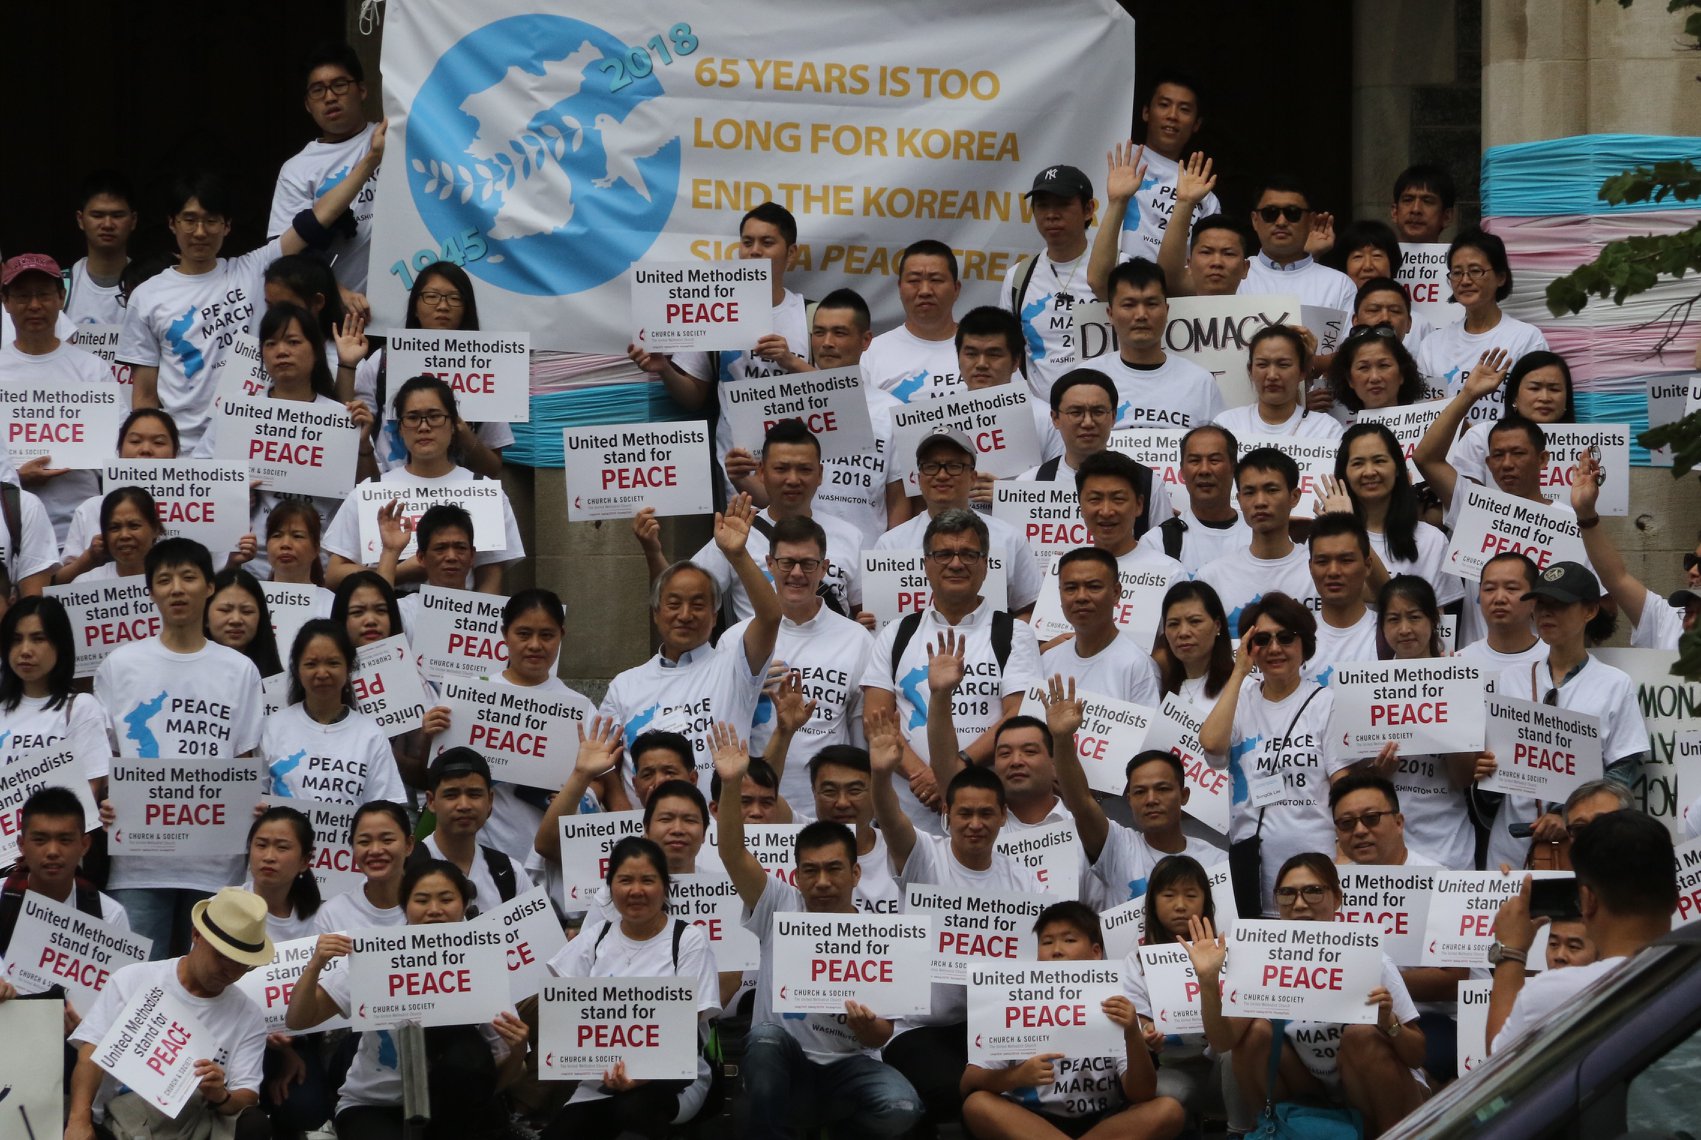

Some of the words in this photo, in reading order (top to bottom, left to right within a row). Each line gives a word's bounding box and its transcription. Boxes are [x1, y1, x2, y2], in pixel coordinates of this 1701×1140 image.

[601, 27, 697, 94] 2018
[694, 57, 740, 88] 65
[746, 58, 871, 94] YEARS
[879, 65, 910, 98] IS
[916, 67, 1000, 101] TOO
[693, 117, 802, 154] LONG
[810, 124, 888, 157] FOR
[897, 128, 1020, 162] KOREA
[779, 183, 854, 216] THE
[863, 186, 1011, 222] KOREAN
[636, 270, 684, 284] United
[688, 269, 767, 282] Methodists
[669, 286, 706, 299] stand
[714, 285, 735, 298] for
[202, 304, 254, 340] MARCH
[666, 302, 739, 324] PEACE
[392, 338, 440, 352] United
[444, 338, 525, 353] Methodists
[425, 354, 466, 368] stand
[471, 356, 492, 369] for
[32, 390, 115, 404] Methodists
[730, 387, 775, 404] United
[780, 376, 859, 397] Methodists
[13, 406, 55, 419] stand
[60, 406, 81, 419] for
[764, 400, 804, 415] stand
[809, 396, 829, 409] for
[225, 403, 275, 421] United
[279, 406, 358, 431] Methodists
[1134, 408, 1190, 427] PEACE
[9, 423, 84, 443] PEACE
[255, 424, 297, 439] stand
[301, 428, 322, 441] for
[569, 437, 618, 450] United
[622, 431, 704, 445] Methodists
[1544, 433, 1624, 446] Methodists
[249, 440, 324, 468] PEACE
[604, 451, 645, 464] stand
[650, 449, 671, 461] for
[109, 468, 157, 481] United
[161, 468, 245, 482] Methodists
[601, 466, 677, 490] PEACE
[832, 471, 872, 487] 2018
[415, 488, 497, 498] Methodists
[819, 495, 868, 504] WASHINGTON
[1468, 492, 1510, 516] United
[1491, 518, 1531, 539] stand
[1534, 529, 1554, 546] for
[85, 617, 161, 647] PEACE
[1339, 670, 1389, 684] United
[1394, 667, 1479, 682] Methodists
[1374, 685, 1417, 699] stand
[1422, 684, 1444, 697] for
[172, 698, 231, 720] PEACE
[446, 684, 497, 704] United
[501, 693, 583, 720] Methodists
[376, 704, 425, 726] United
[477, 709, 521, 726] stand
[526, 717, 548, 731] for
[1371, 702, 1448, 726] PEACE
[1490, 707, 1531, 725] United
[1535, 712, 1598, 737] Methodists
[166, 720, 231, 741] MARCH
[1356, 733, 1381, 741] CHURCH
[1389, 732, 1413, 740] SOCIETY
[1518, 726, 1552, 744] stand
[1554, 733, 1572, 748] for
[179, 740, 218, 756] 2018
[469, 725, 548, 758] PEACE
[1265, 735, 1314, 747] PEACE
[308, 758, 367, 778] PEACE
[1514, 743, 1576, 774] PEACE
[114, 768, 166, 781] United
[170, 768, 257, 782] Methodists
[1499, 770, 1519, 778] CHURCH
[1527, 775, 1548, 783] SOCIETY
[149, 786, 192, 799] stand
[199, 786, 221, 799] for
[146, 804, 225, 826] PEACE
[26, 902, 71, 929] United
[73, 920, 146, 959] Methodists
[779, 923, 831, 937] United
[836, 923, 926, 938] Methodists
[1236, 929, 1287, 943] United
[1292, 931, 1379, 947] Methodists
[50, 932, 87, 956] stand
[92, 946, 112, 964] for
[353, 939, 407, 953] United
[411, 930, 500, 949] Methodists
[815, 941, 860, 955] stand
[867, 941, 889, 955] for
[938, 932, 1018, 958] PEACE
[391, 953, 437, 969] stand
[442, 952, 465, 965] for
[1269, 947, 1314, 962] stand
[1319, 948, 1341, 962] for
[38, 947, 109, 992] PEACE
[811, 959, 892, 983] PEACE
[973, 971, 1027, 985] United
[1030, 970, 1118, 984] Methodists
[1263, 965, 1343, 990] PEACE
[389, 970, 471, 996] PEACE
[544, 988, 599, 1002] United
[603, 987, 693, 1001] Methodists
[1009, 987, 1054, 1000] stand
[1060, 987, 1082, 999] for
[1244, 994, 1269, 1002] CHURCH
[1278, 995, 1304, 1003] SOCIETY
[373, 1005, 398, 1013] CHURCH
[581, 1005, 626, 1019] stand
[633, 1005, 655, 1019] for
[1005, 1005, 1086, 1028] PEACE
[101, 1038, 129, 1068] United
[128, 986, 164, 1039] Methodists
[135, 1029, 158, 1058] stand
[152, 1013, 168, 1035] for
[577, 1025, 659, 1047] PEACE
[147, 1021, 191, 1076] PEACE
[1060, 1057, 1115, 1075] PEACE
[1054, 1075, 1118, 1094] MARCH
[1066, 1098, 1107, 1113] 2018
